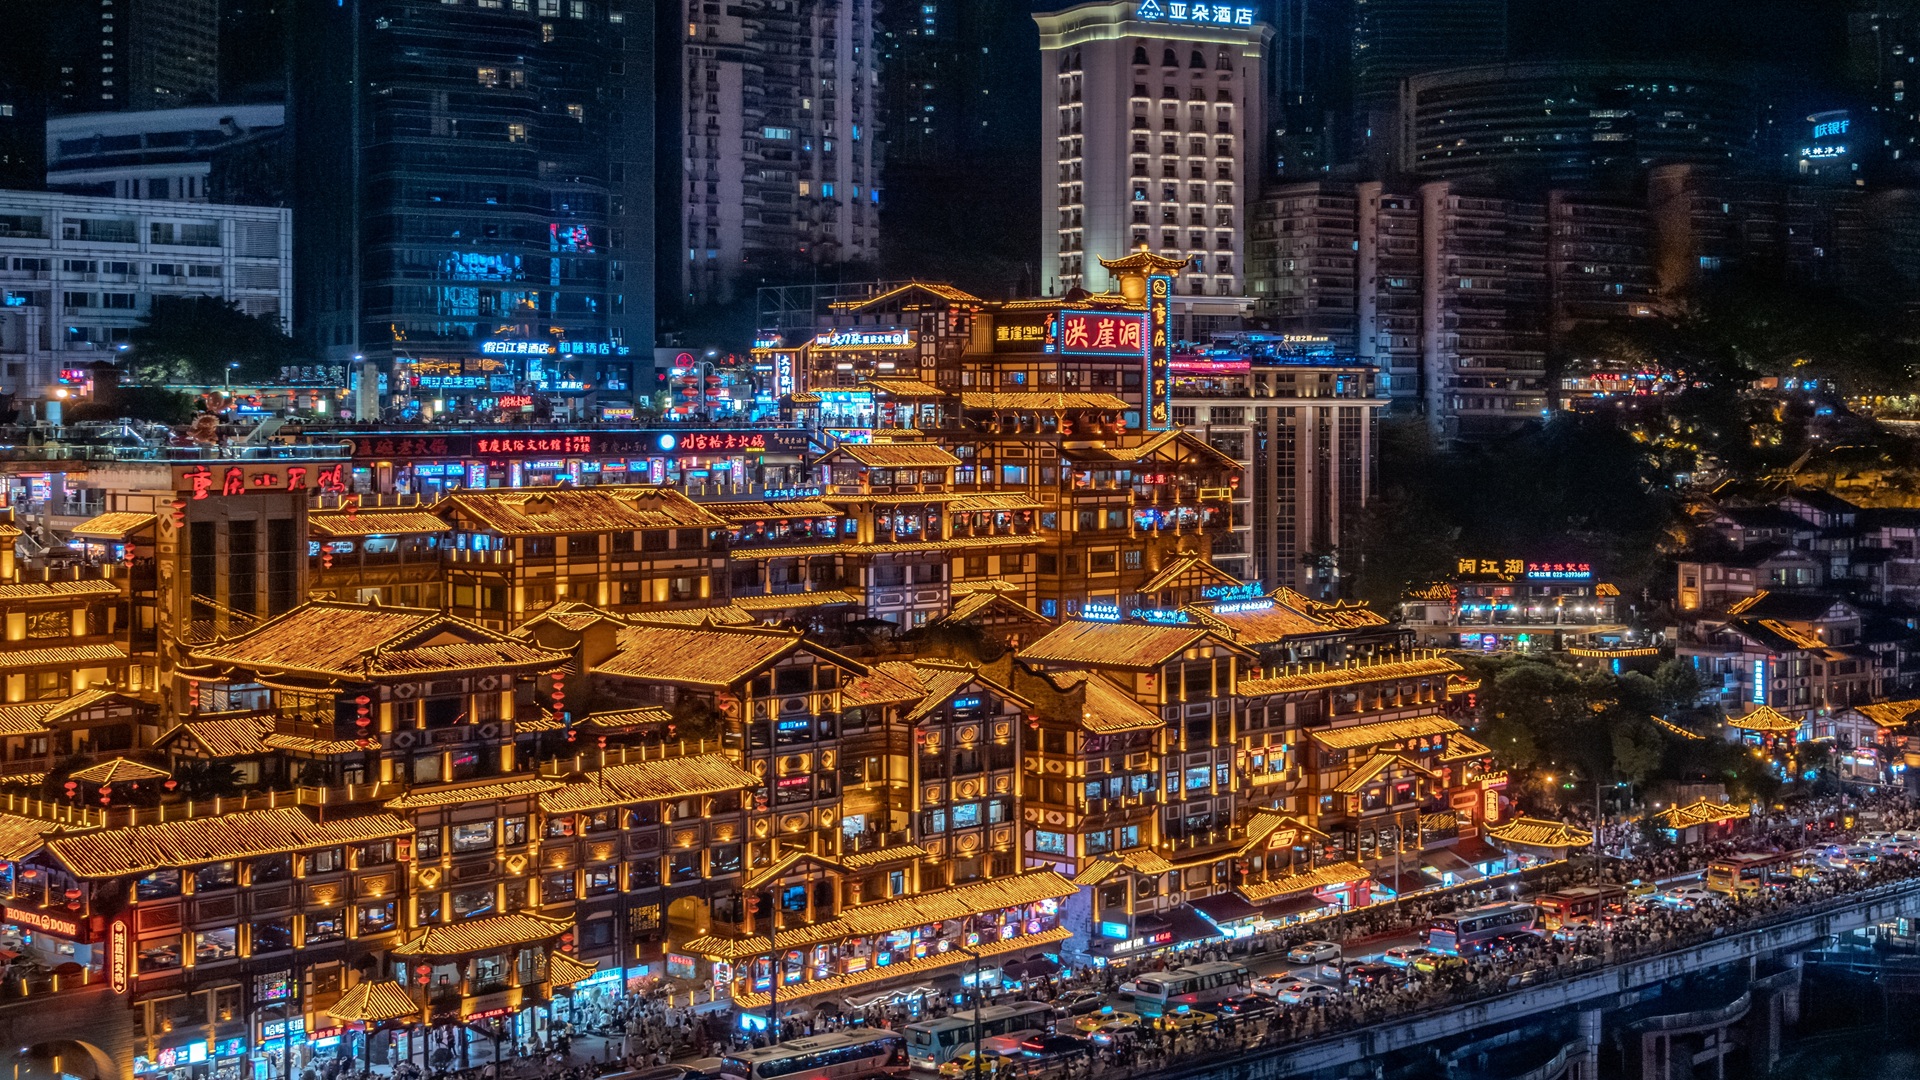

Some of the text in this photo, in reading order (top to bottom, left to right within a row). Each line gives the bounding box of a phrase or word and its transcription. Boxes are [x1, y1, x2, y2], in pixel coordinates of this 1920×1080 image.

[1169, 2, 1253, 25] 亚朵酒店
[1064, 317, 1142, 349] 洪崖洞
[482, 340, 549, 354] 假日江景酒店
[558, 341, 630, 355] 和颐酒店 3F
[1153, 302, 1168, 421] 重庆小天鹅
[538, 381, 584, 390] 假江景酒店
[477, 439, 562, 453] 重慶民俗文化館
[680, 433, 766, 449] 九宫格老火锅
[183, 465, 346, 500] 重庆小天鹅
[1458, 558, 1525, 575] 闹江湖
[6, 907, 77, 935] HONGYA DONG
